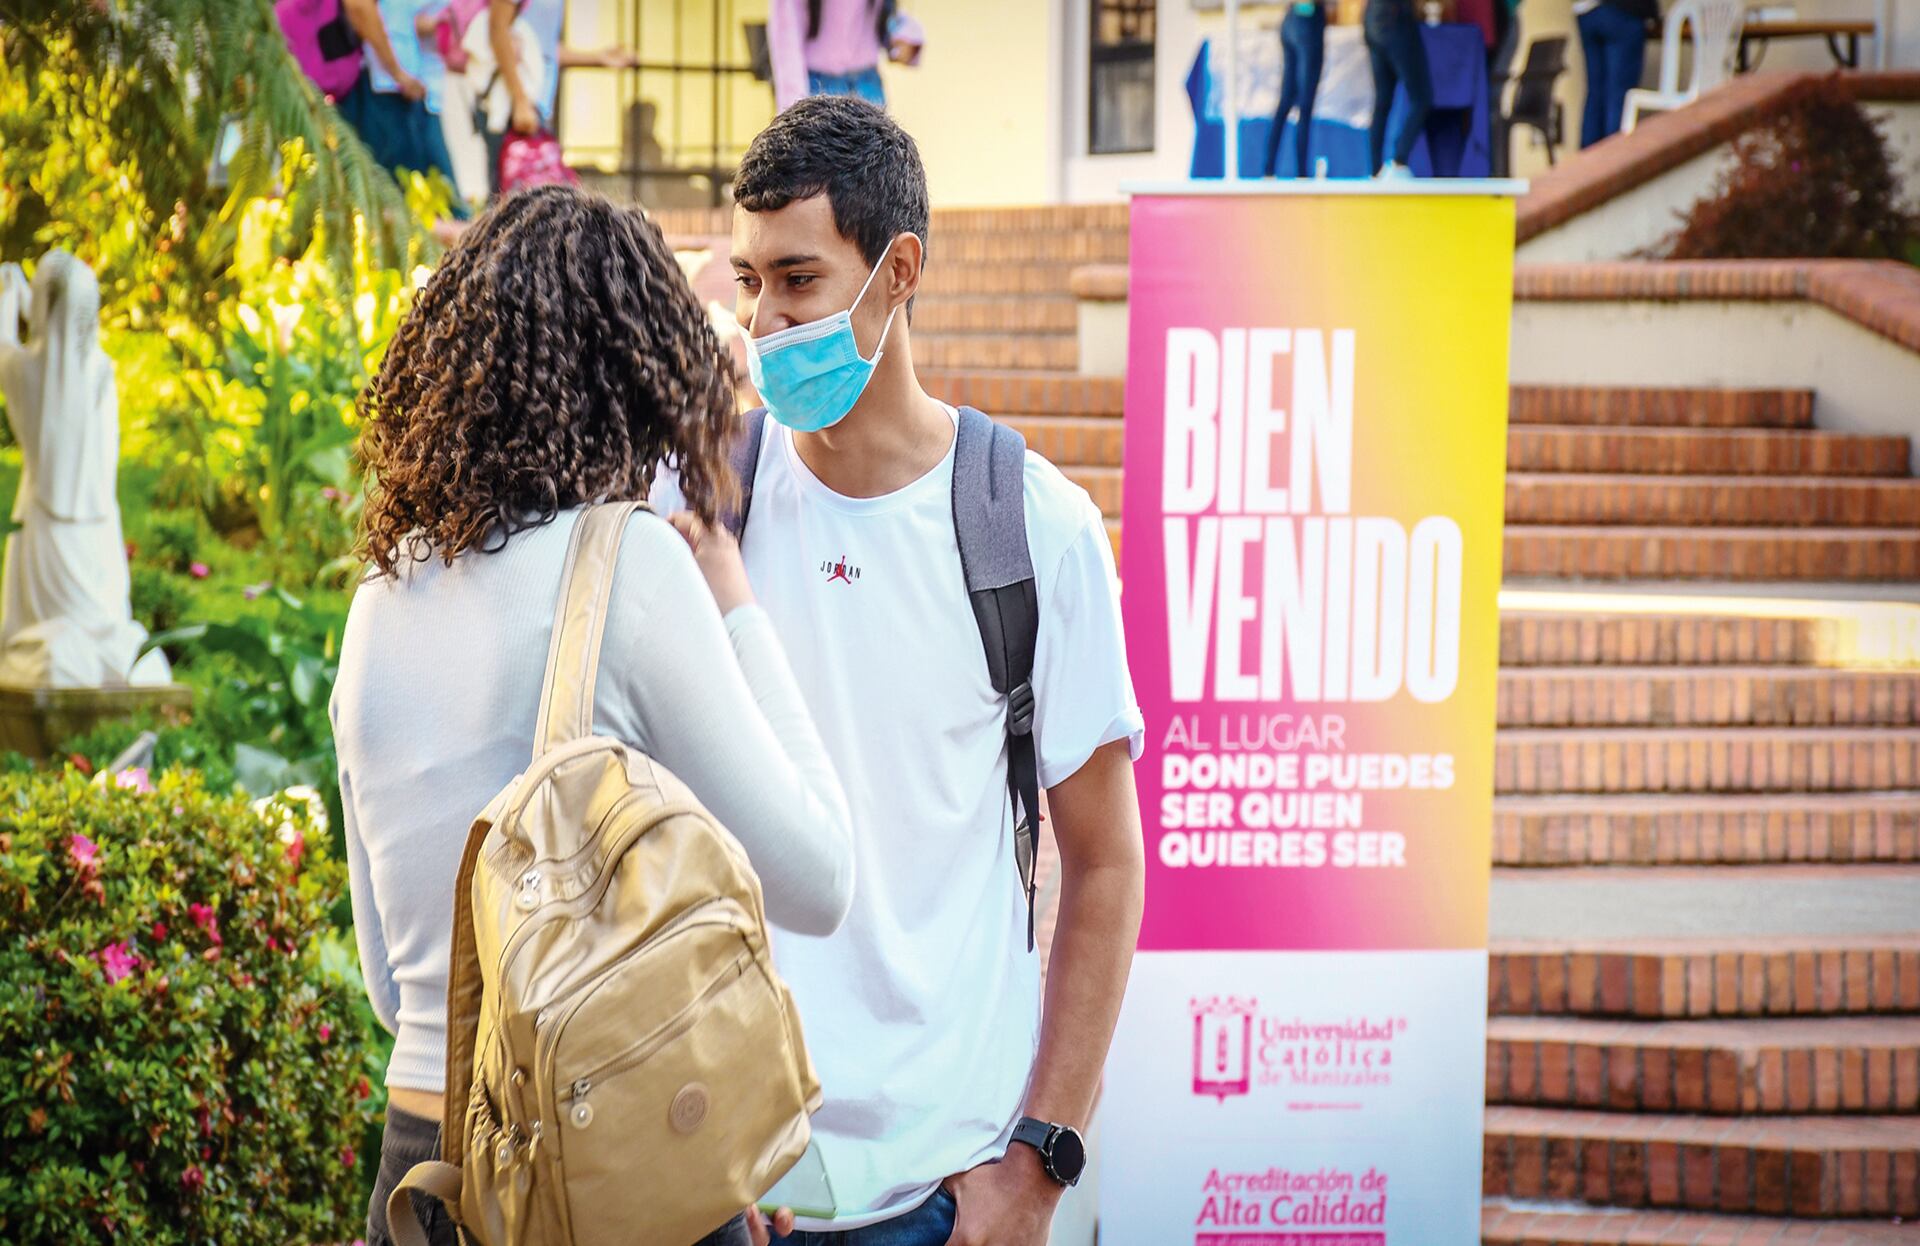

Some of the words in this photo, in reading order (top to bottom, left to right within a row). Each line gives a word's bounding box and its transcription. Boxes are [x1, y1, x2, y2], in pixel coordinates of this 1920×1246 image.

[1162, 327, 1356, 514] BIEN
[1162, 516, 1463, 703] VENIDO
[1162, 715, 1211, 750] AL
[1219, 714, 1347, 751] LUGAR
[1161, 754, 1299, 789] DONDE
[1304, 754, 1455, 789] PUEDES
[1160, 792, 1234, 829] SER
[1240, 792, 1362, 829] QUIEN
[1159, 832, 1327, 868] QUIERES
[1331, 832, 1406, 868] SER
[1258, 1043, 1392, 1067] Católica
[1257, 1066, 1281, 1086] de
[1290, 1066, 1392, 1086] Manizales
[1203, 1167, 1354, 1193] Acreditación
[1359, 1167, 1388, 1192] de
[1196, 1195, 1262, 1226] Alta
[1269, 1194, 1387, 1226] Calidad
